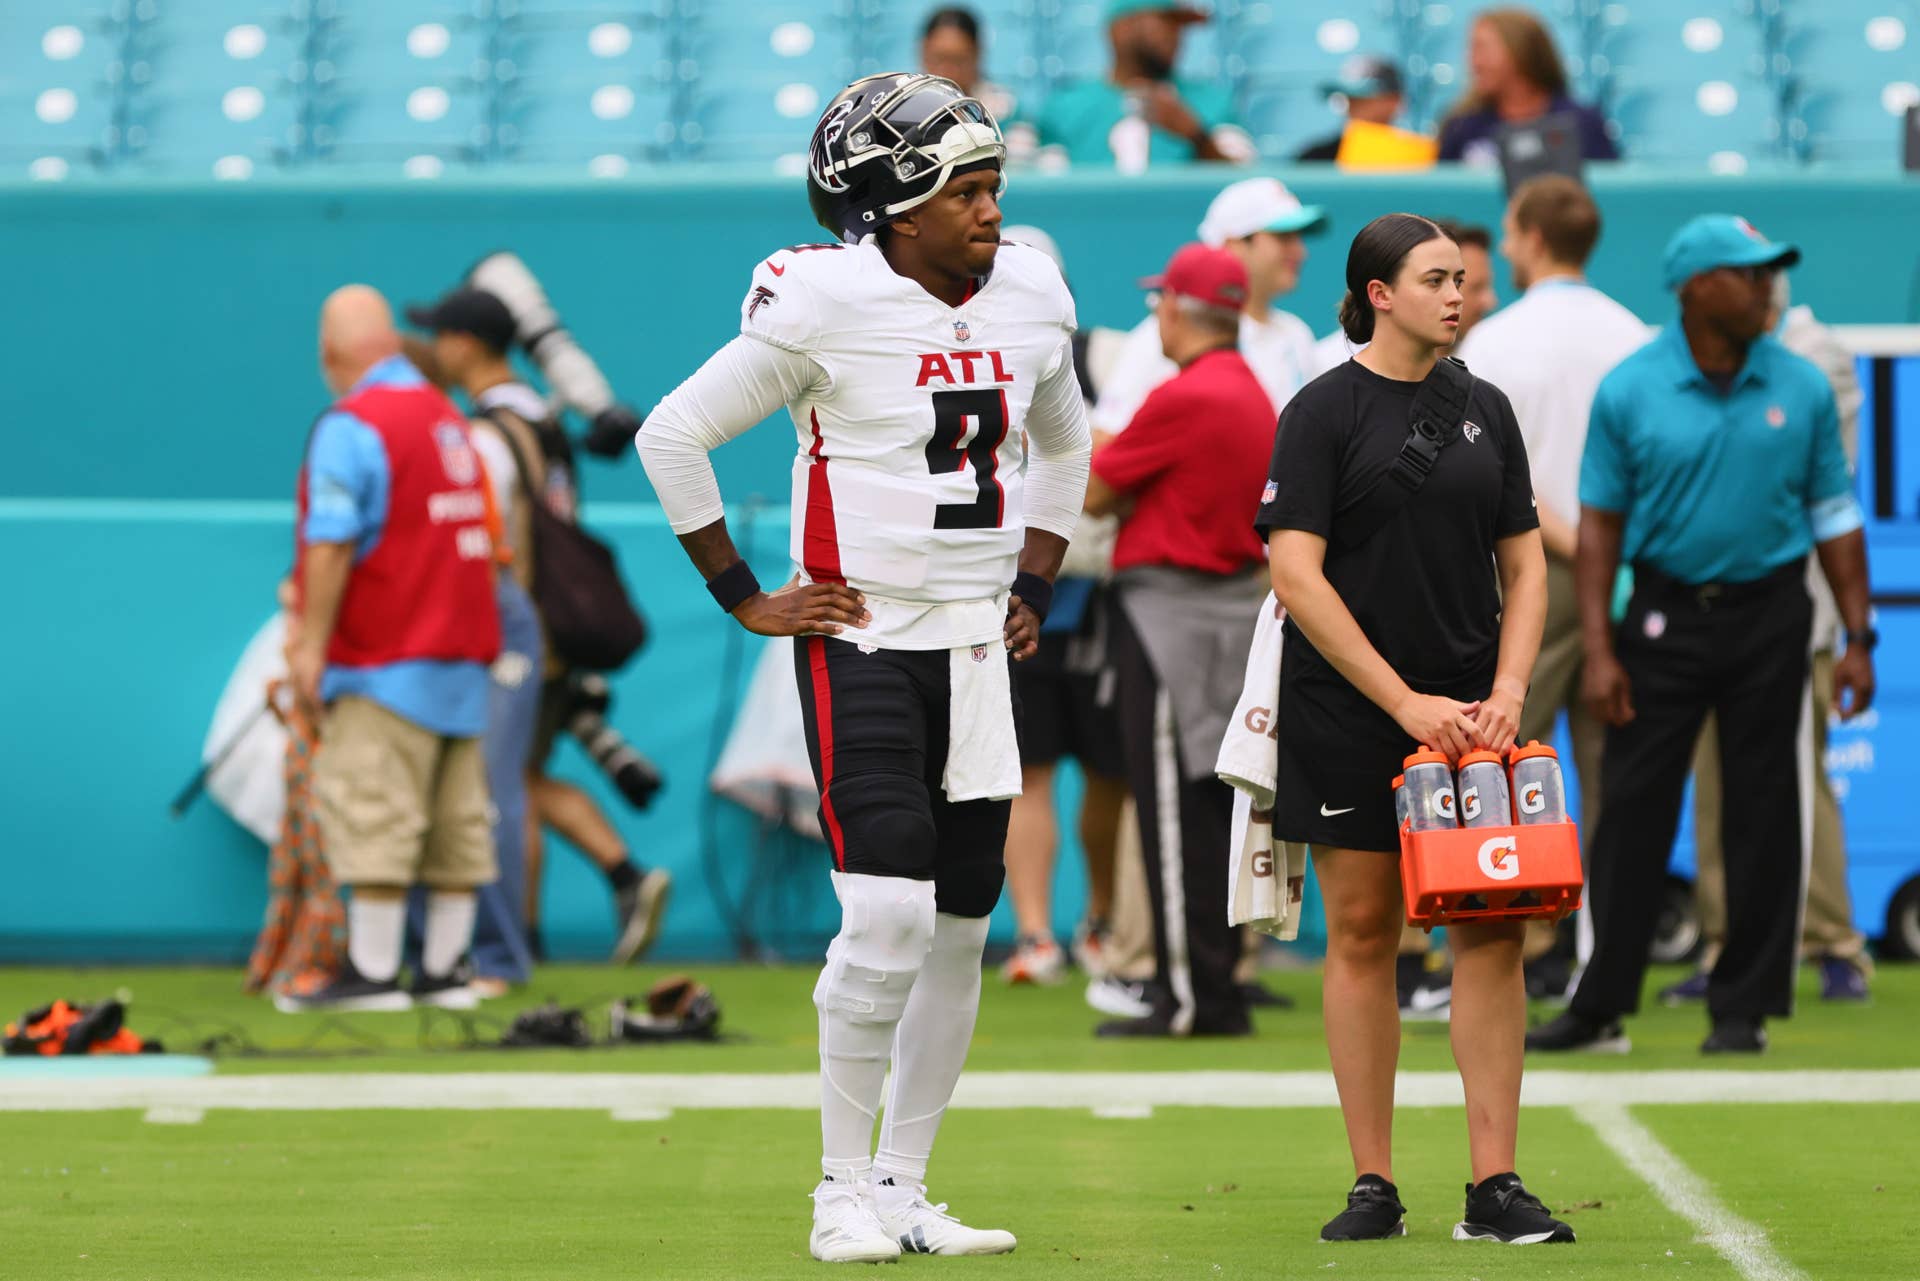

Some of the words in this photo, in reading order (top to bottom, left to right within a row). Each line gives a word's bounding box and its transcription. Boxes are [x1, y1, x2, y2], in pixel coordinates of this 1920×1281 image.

[916, 351, 1014, 386] ATL
[925, 388, 1009, 530] 9
[1432, 787, 1456, 819] G
[1461, 786, 1481, 821] G
[1520, 781, 1545, 815] G
[1477, 836, 1520, 880] G
